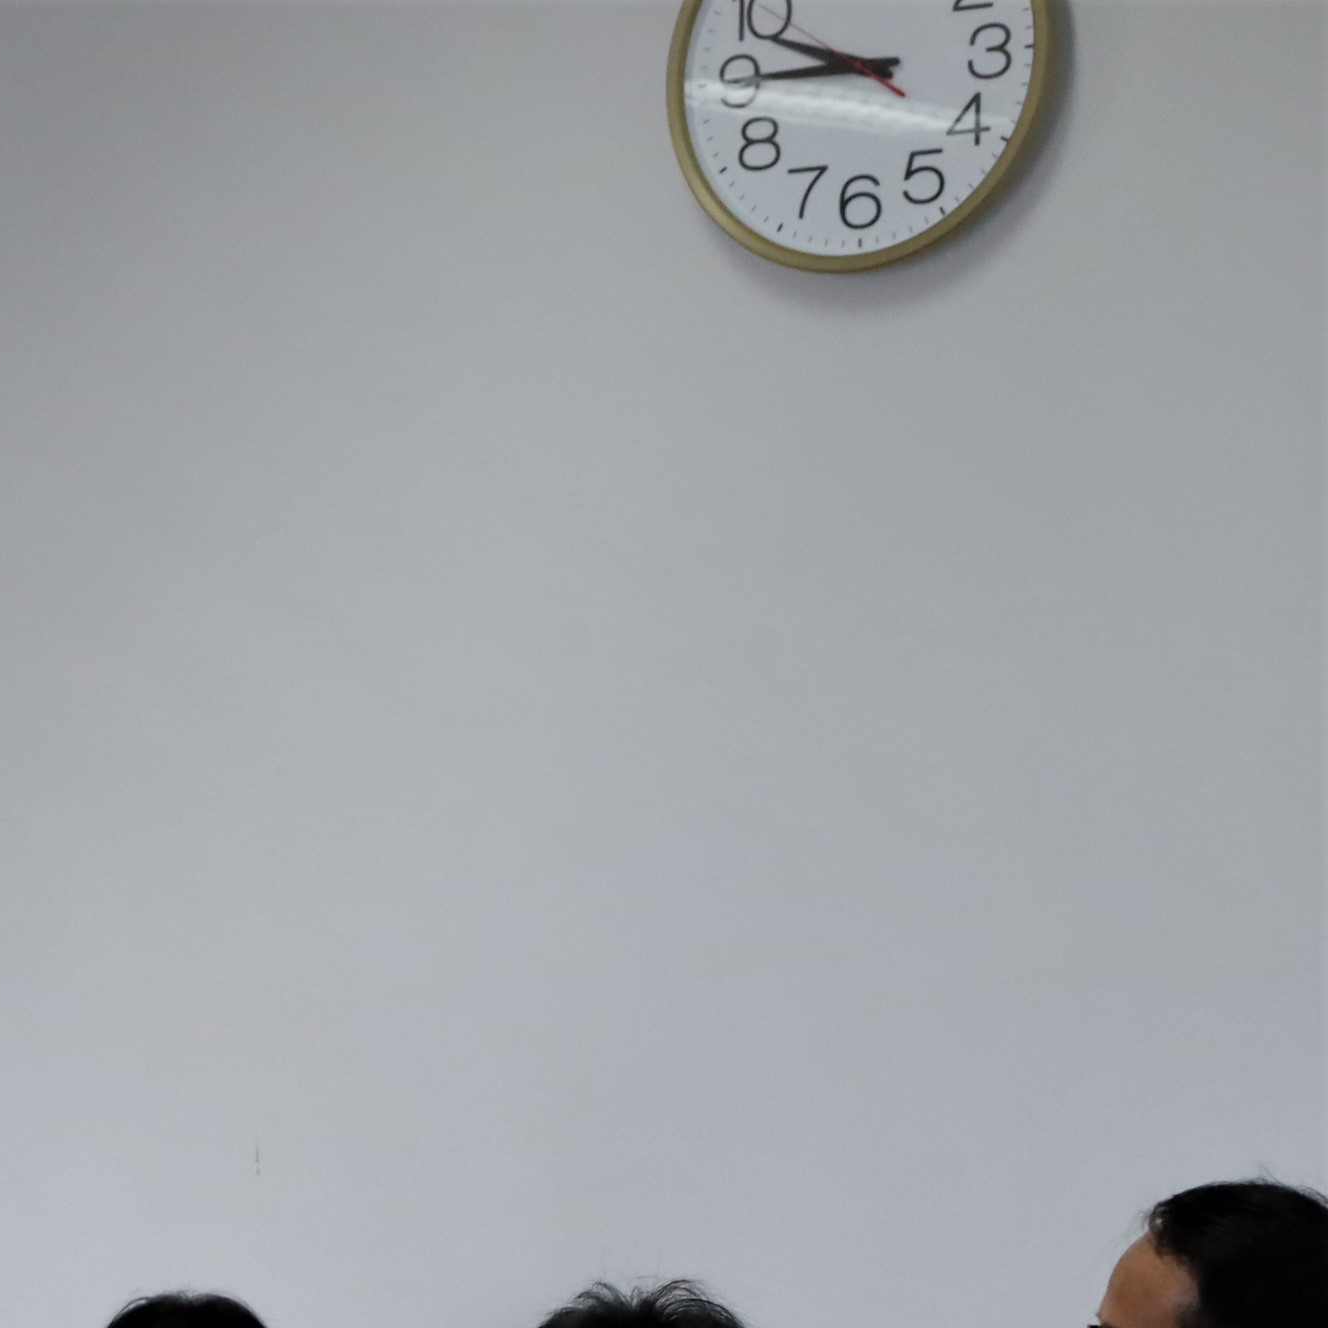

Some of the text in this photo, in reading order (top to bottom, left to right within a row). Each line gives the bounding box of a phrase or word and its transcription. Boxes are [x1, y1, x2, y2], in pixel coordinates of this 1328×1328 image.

[967, 22, 1012, 80] 3
[719, 54, 761, 108] 9
[738, 116, 781, 171] 8
[946, 92, 991, 146] 4
[787, 164, 829, 219] 7
[839, 174, 882, 230] 6
[902, 148, 945, 204] 5
